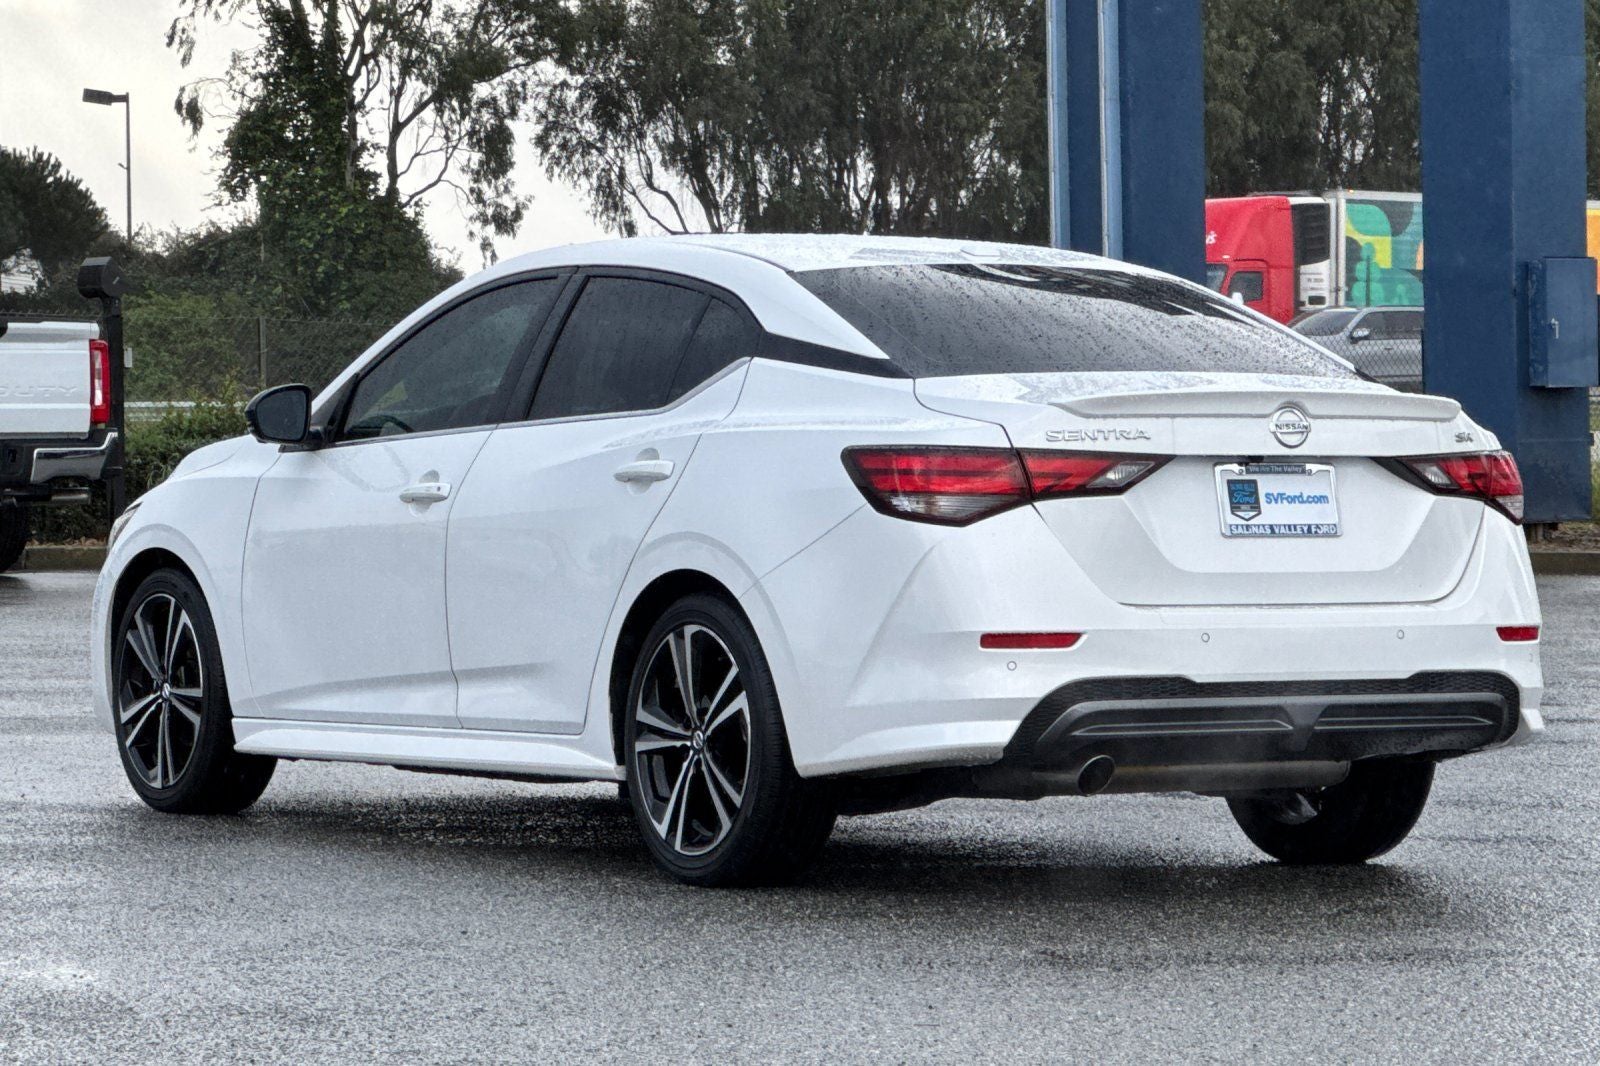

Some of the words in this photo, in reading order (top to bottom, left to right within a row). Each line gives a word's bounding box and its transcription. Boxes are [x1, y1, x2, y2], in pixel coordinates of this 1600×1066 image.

[1045, 427, 1151, 442] SENTRA
[1232, 491, 1256, 504] Ford
[1264, 492, 1329, 504] SVFord.com
[1231, 525, 1272, 535] SALINAS
[1272, 525, 1308, 535] VALLEY
[1311, 525, 1336, 535] FORD
